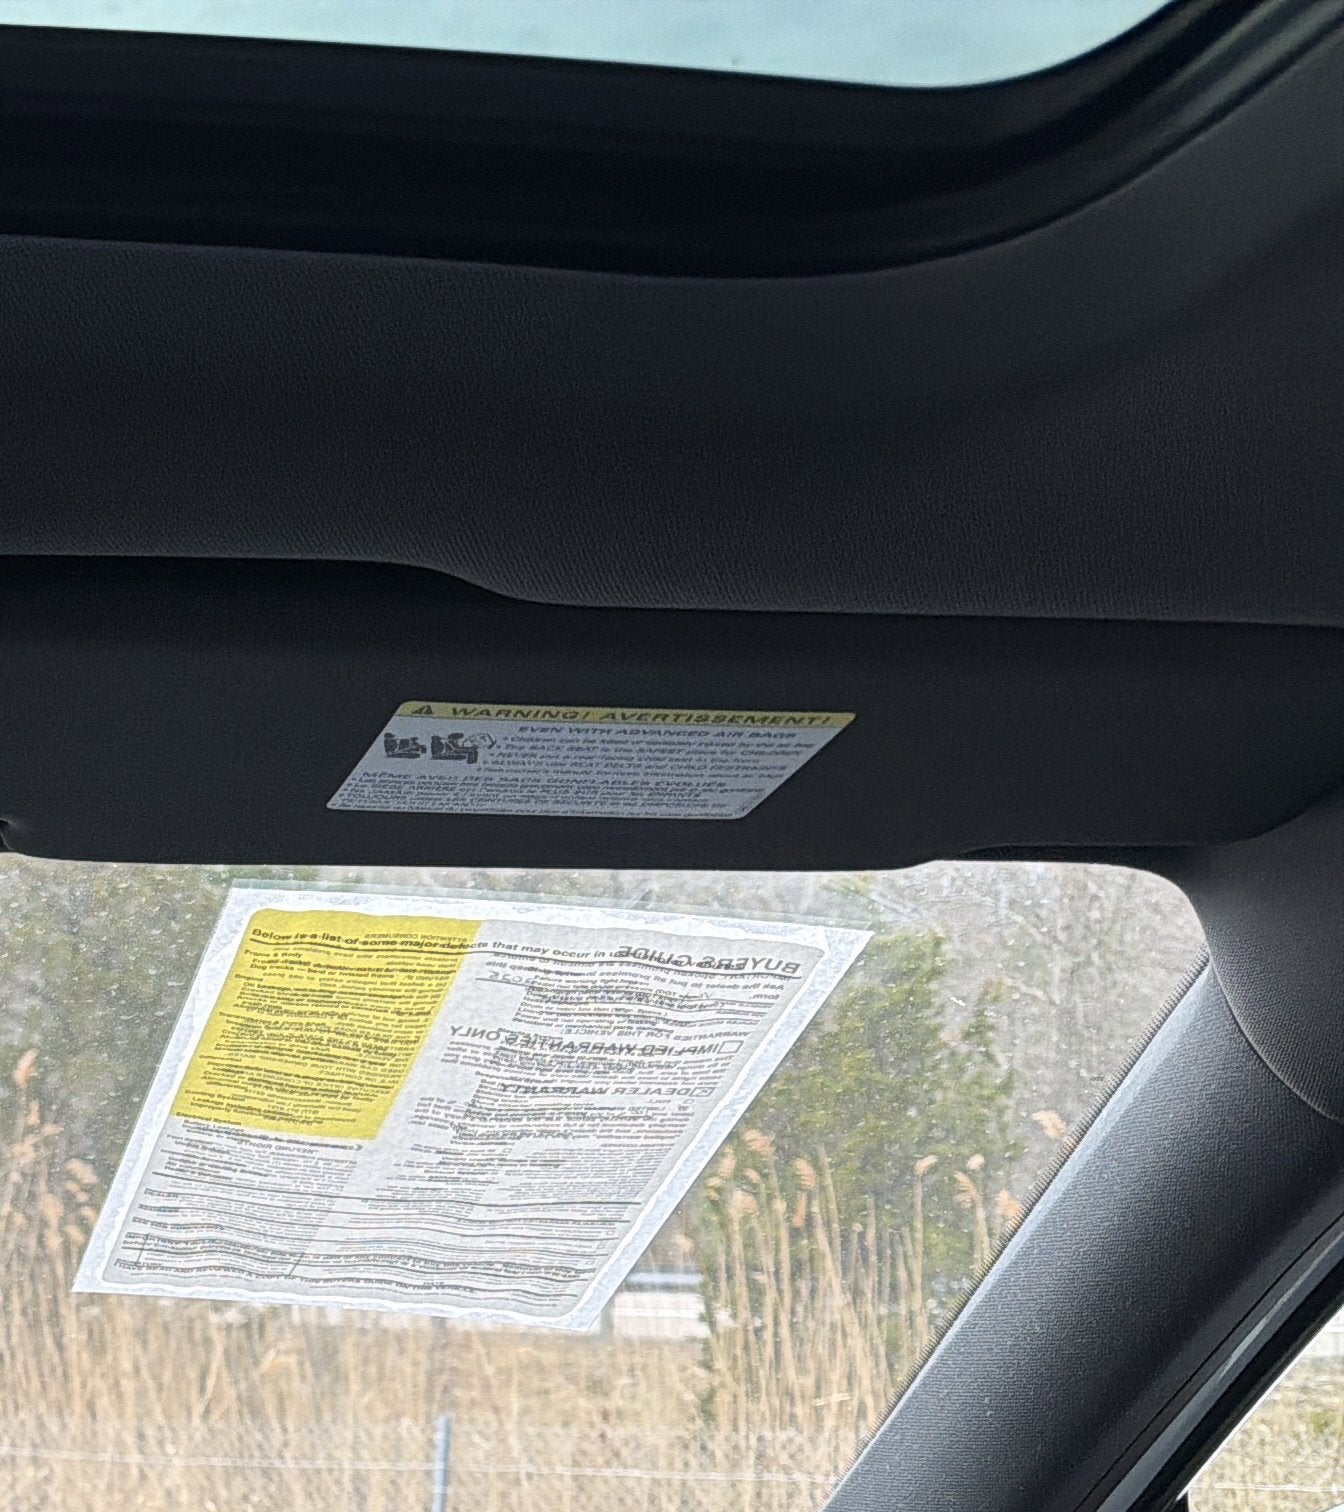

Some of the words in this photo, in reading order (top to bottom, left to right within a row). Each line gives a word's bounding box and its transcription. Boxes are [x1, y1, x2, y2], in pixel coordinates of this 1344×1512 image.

[451, 706, 590, 720] WARNING!
[600, 713, 831, 724] AVERTISSEMENT!
[252, 928, 293, 941] Below
[492, 941, 518, 951] that
[521, 945, 550, 955] may
[552, 948, 591, 959] occur
[593, 950, 606, 958] in
